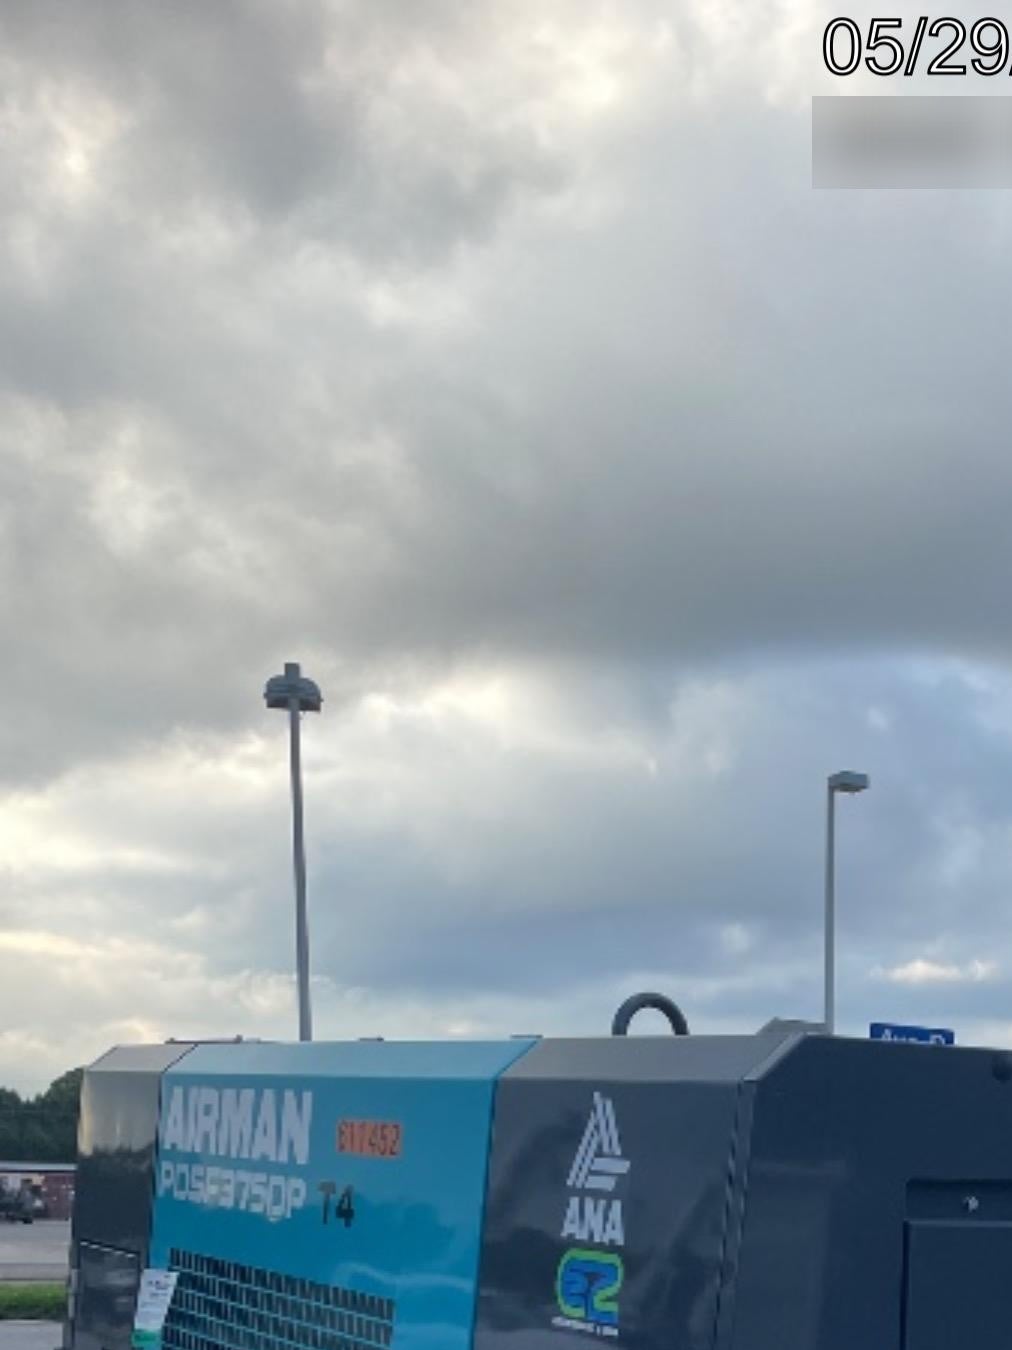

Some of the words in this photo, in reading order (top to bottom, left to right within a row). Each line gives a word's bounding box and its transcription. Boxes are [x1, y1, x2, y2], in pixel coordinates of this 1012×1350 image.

[162, 1086, 313, 1165] AIRMAN
[317, 1181, 355, 1228] T4
[560, 1196, 625, 1246] ANA
